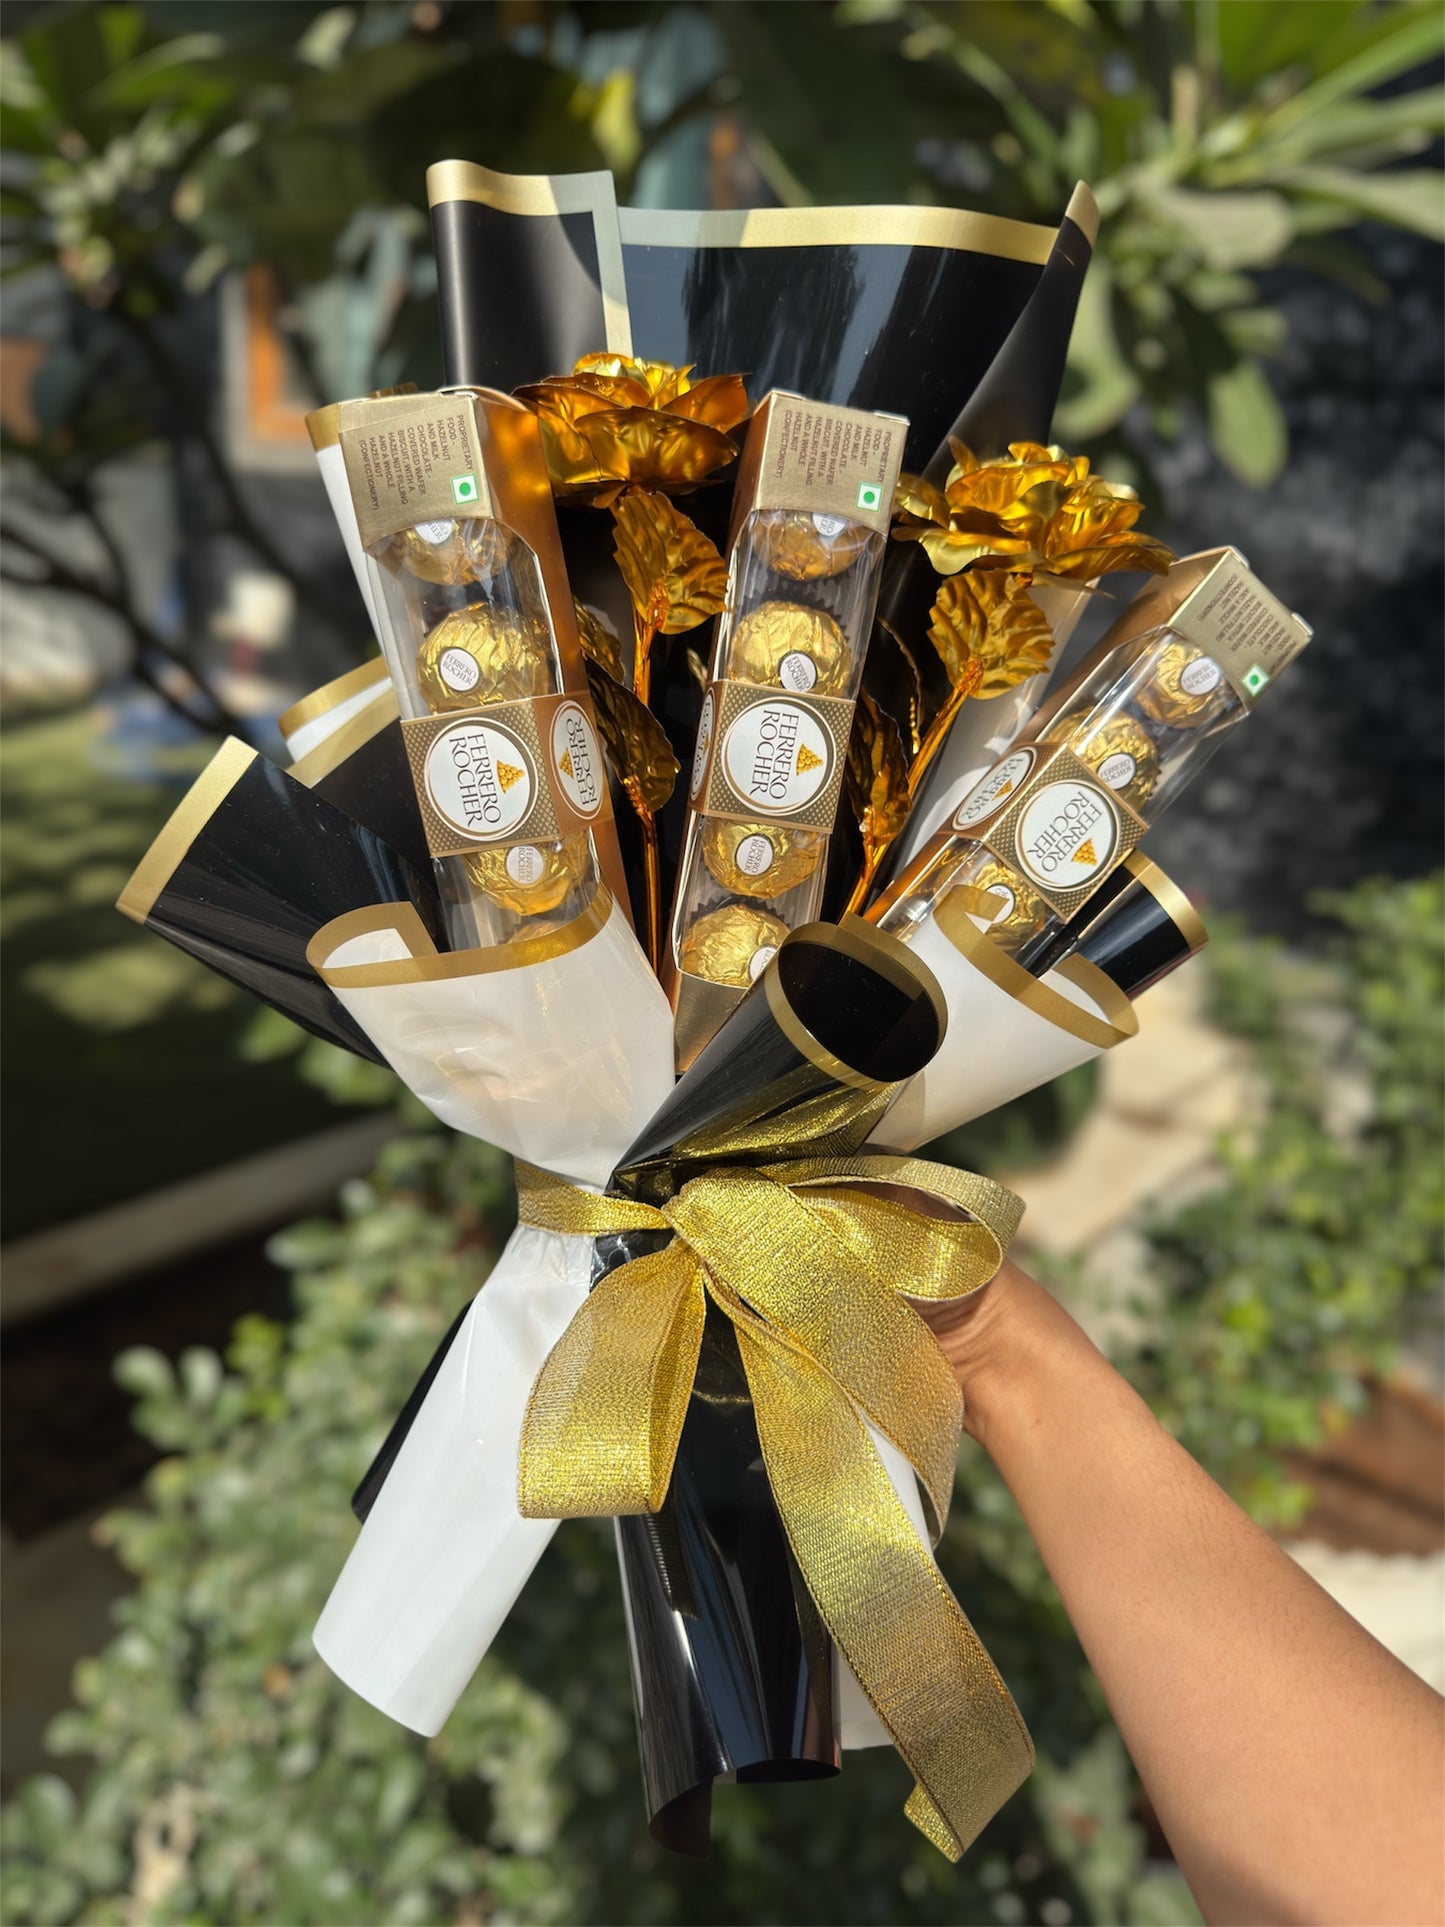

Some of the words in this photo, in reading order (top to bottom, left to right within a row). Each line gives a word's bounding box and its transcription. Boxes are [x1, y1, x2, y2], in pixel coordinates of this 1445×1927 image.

[427, 422, 436, 440] AND
[437, 419, 451, 461] HAZELNUT
[447, 416, 458, 440] FOOD
[457, 414, 474, 471] PROPRIETARY
[790, 411, 802, 452] HAZELNUT
[804, 413, 813, 431] AND
[810, 416, 822, 457] HAZELNUT
[831, 420, 843, 458] COVERED
[853, 424, 862, 441] AND
[872, 428, 883, 451] FOOD
[369, 436, 383, 478] HAZELNUT
[378, 435, 388, 452] AND
[383, 460, 396, 489] WHOLE
[407, 427, 421, 466] COVERED
[414, 466, 427, 496] WAFER
[416, 424, 433, 473] CHOCOLATE
[430, 440, 441, 461] MILK
[775, 409, 793, 479] (CONFECTIONERY)
[798, 438, 809, 466] WHOLE
[817, 450, 828, 470] WITH
[839, 422, 853, 470] CHOCOLATE
[850, 441, 861, 461] MILK
[860, 426, 873, 467] HAZELNUT
[359, 439, 379, 511] (CONFECTIONERY)
[388, 432, 402, 473] HAZELNUT
[396, 473, 409, 506] FILLING
[404, 464, 414, 485] WITH
[805, 457, 817, 486] FILLING
[826, 458, 837, 486] WAFER
[442, 660, 473, 685] ROCHER
[446, 653, 477, 679] FERRERO
[792, 655, 811, 689] FERRERO
[566, 718, 590, 805] FERRERO
[574, 715, 598, 803] ROCHER
[749, 710, 781, 795] ROCHER
[769, 713, 799, 800] FERRERO
[449, 736, 483, 828] ROCHER
[468, 733, 502, 824] FERRERO
[1026, 791, 1091, 860] ROCHER
[1041, 803, 1103, 873] FERRERO
[744, 838, 759, 871] ROCHER
[752, 840, 767, 873] FERRERO
